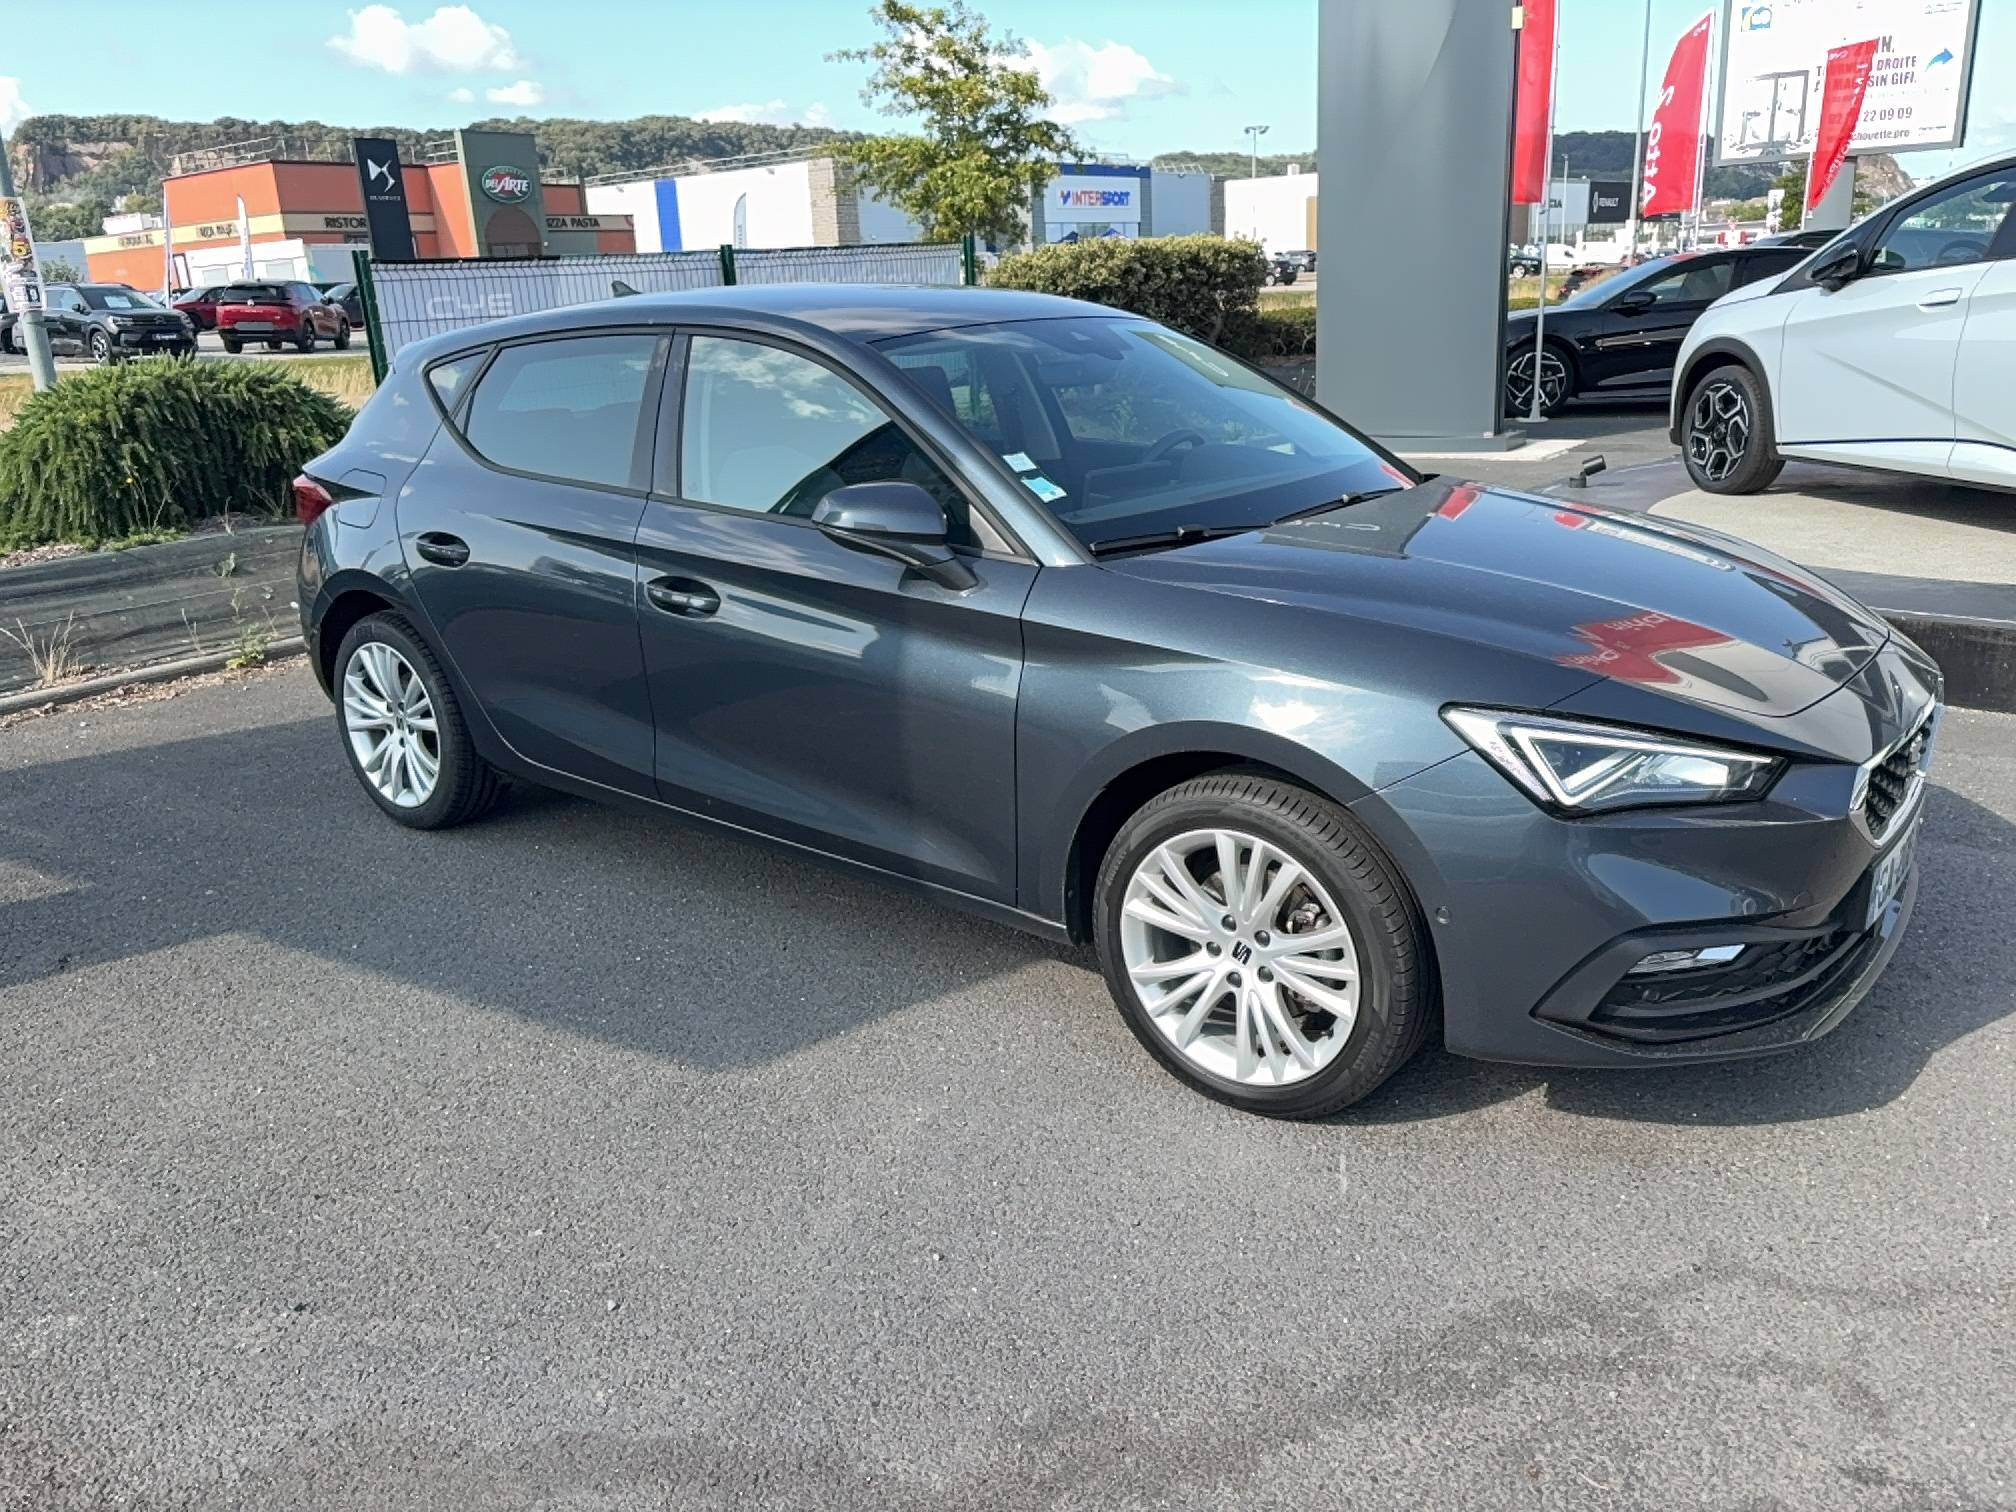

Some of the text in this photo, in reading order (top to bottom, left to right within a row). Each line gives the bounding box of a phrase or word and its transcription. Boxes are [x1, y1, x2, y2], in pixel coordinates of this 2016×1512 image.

[1876, 55, 1917, 71] DROITE
[1072, 190, 1130, 207] INTERSPORT
[570, 217, 600, 228] PASTA
